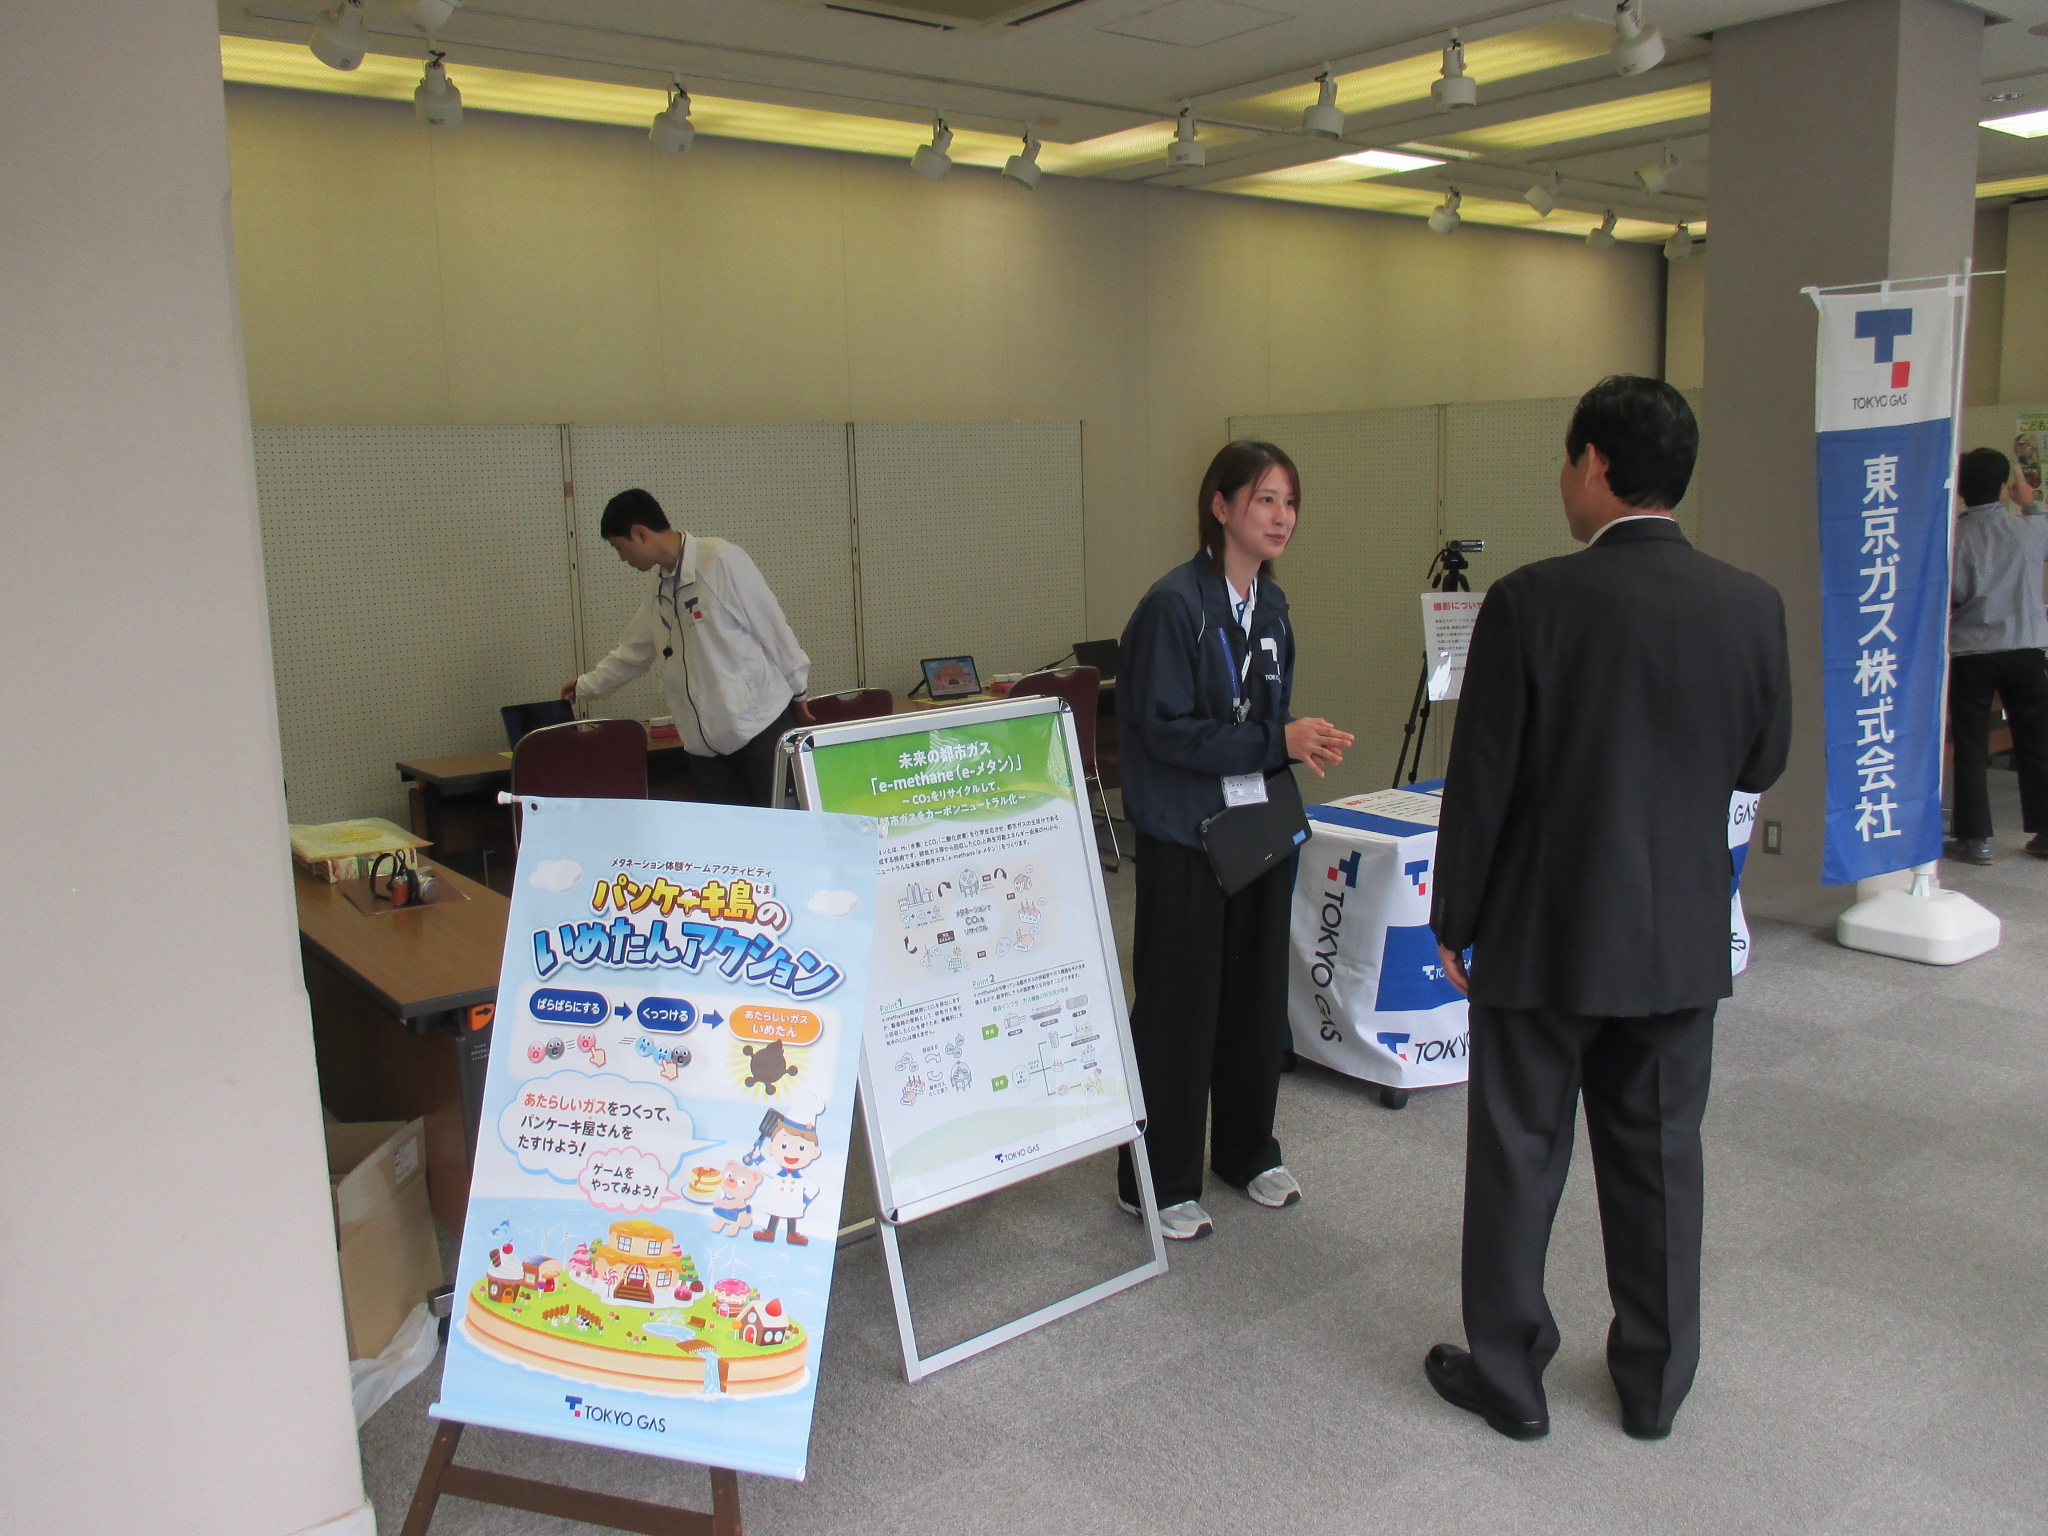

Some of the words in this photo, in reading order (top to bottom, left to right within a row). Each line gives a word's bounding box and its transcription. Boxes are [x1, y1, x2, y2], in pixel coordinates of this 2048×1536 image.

[1852, 395, 1887, 410] TOKYO
[1889, 393, 1907, 407] GAS
[1853, 454, 1902, 842] 東京ガス株式会社
[898, 741, 991, 769] 未来の都市ガス
[611, 858, 772, 878] メタネーション体験ゲームアクティビティ
[755, 884, 771, 895] じま
[592, 872, 787, 932] パンケーキ島の
[964, 925, 988, 936] リサイクル
[1311, 891, 1345, 988] TOKYO
[533, 916, 841, 997] いめたんアクション
[536, 998, 600, 1015] ばらばらにする
[642, 1007, 689, 1022] くっつける
[744, 1010, 808, 1025] あたらしいガス
[1314, 993, 1343, 1043] GAS
[753, 1024, 797, 1038] いめたん
[1415, 1031, 1470, 1065] TOKY
[524, 1092, 671, 1122] あたらしいガスをつくって、
[521, 1114, 634, 1140] パンケーキ屋さんを
[518, 1134, 587, 1157] たすけよう！
[1004, 1148, 1027, 1161] TOKYO
[1027, 1143, 1040, 1154] GAS
[593, 1163, 634, 1179] ゲームを
[591, 1178, 659, 1199] やってみよう！
[585, 1405, 633, 1427] TOKYO
[637, 1415, 666, 1433] GAS
